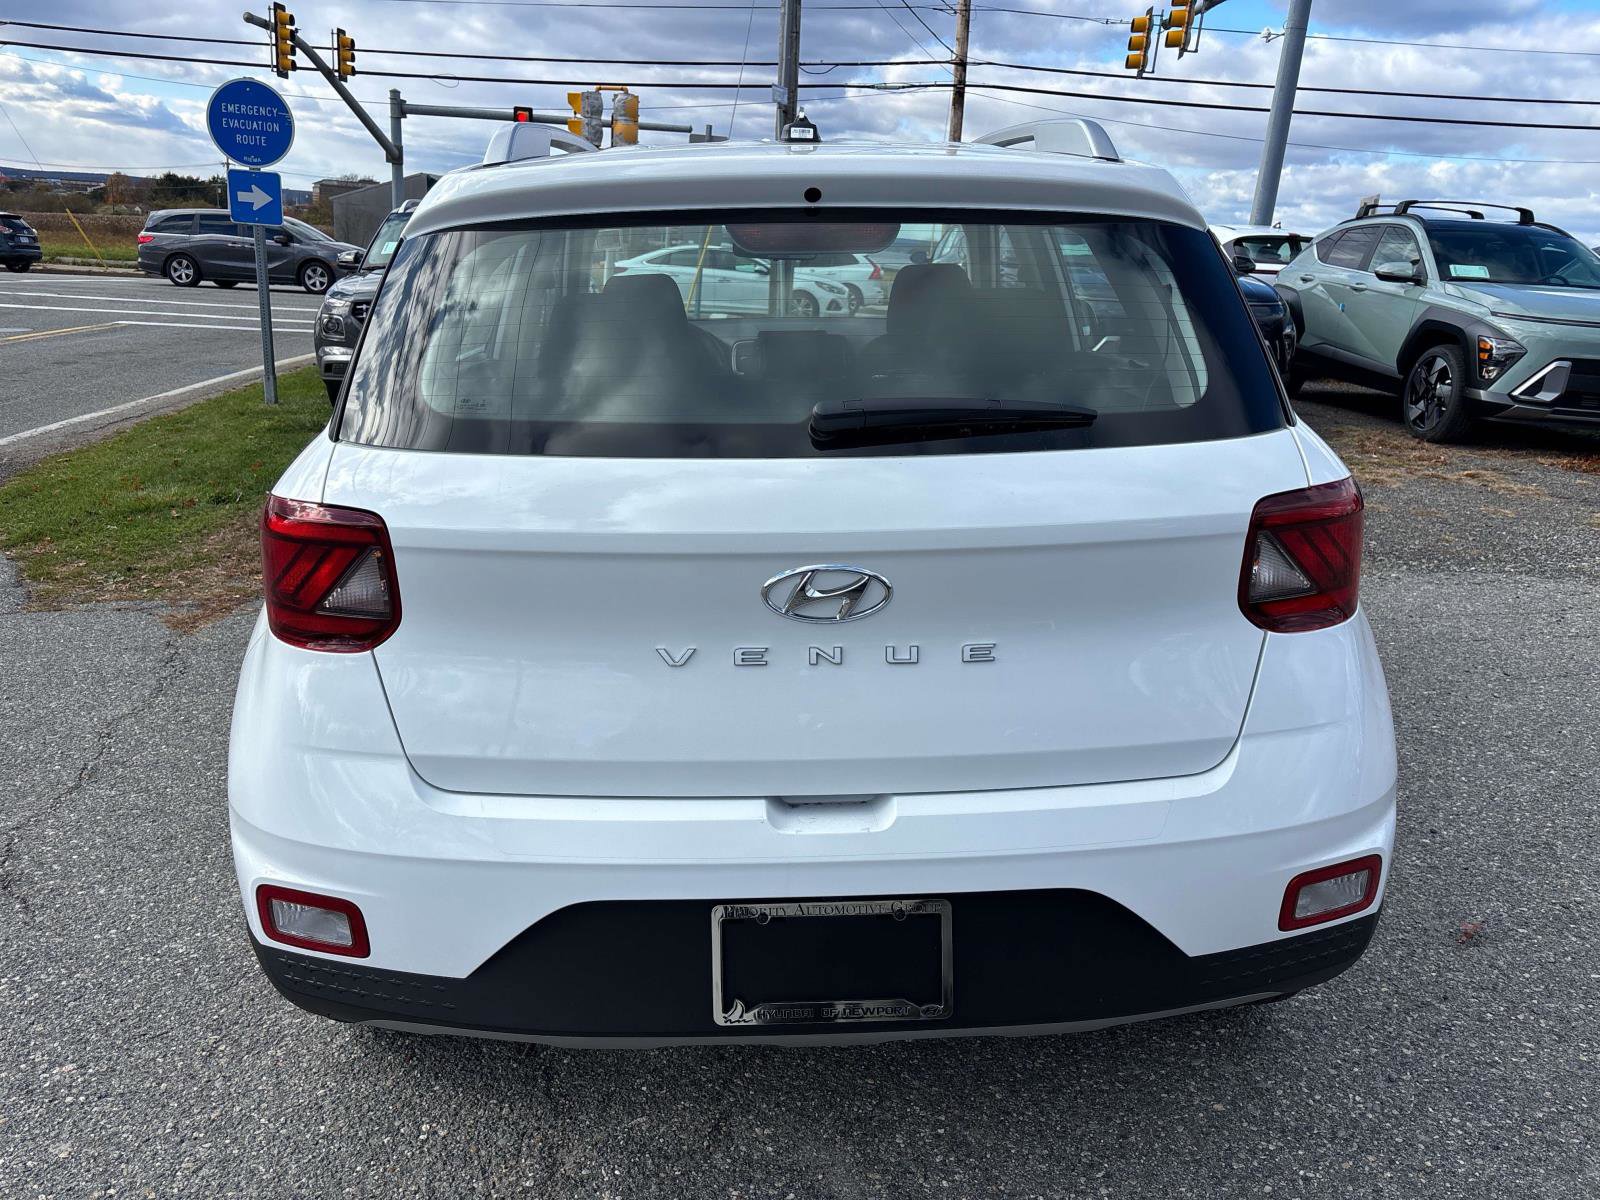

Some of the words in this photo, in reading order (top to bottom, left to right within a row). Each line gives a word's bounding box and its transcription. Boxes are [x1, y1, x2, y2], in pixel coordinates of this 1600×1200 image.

[221, 102, 278, 117] EMERGENCY
[222, 118, 280, 132] EVACUATION
[236, 134, 267, 146] ROUTE
[655, 642, 996, 667] VENUE
[821, 1007, 839, 1018] OF
